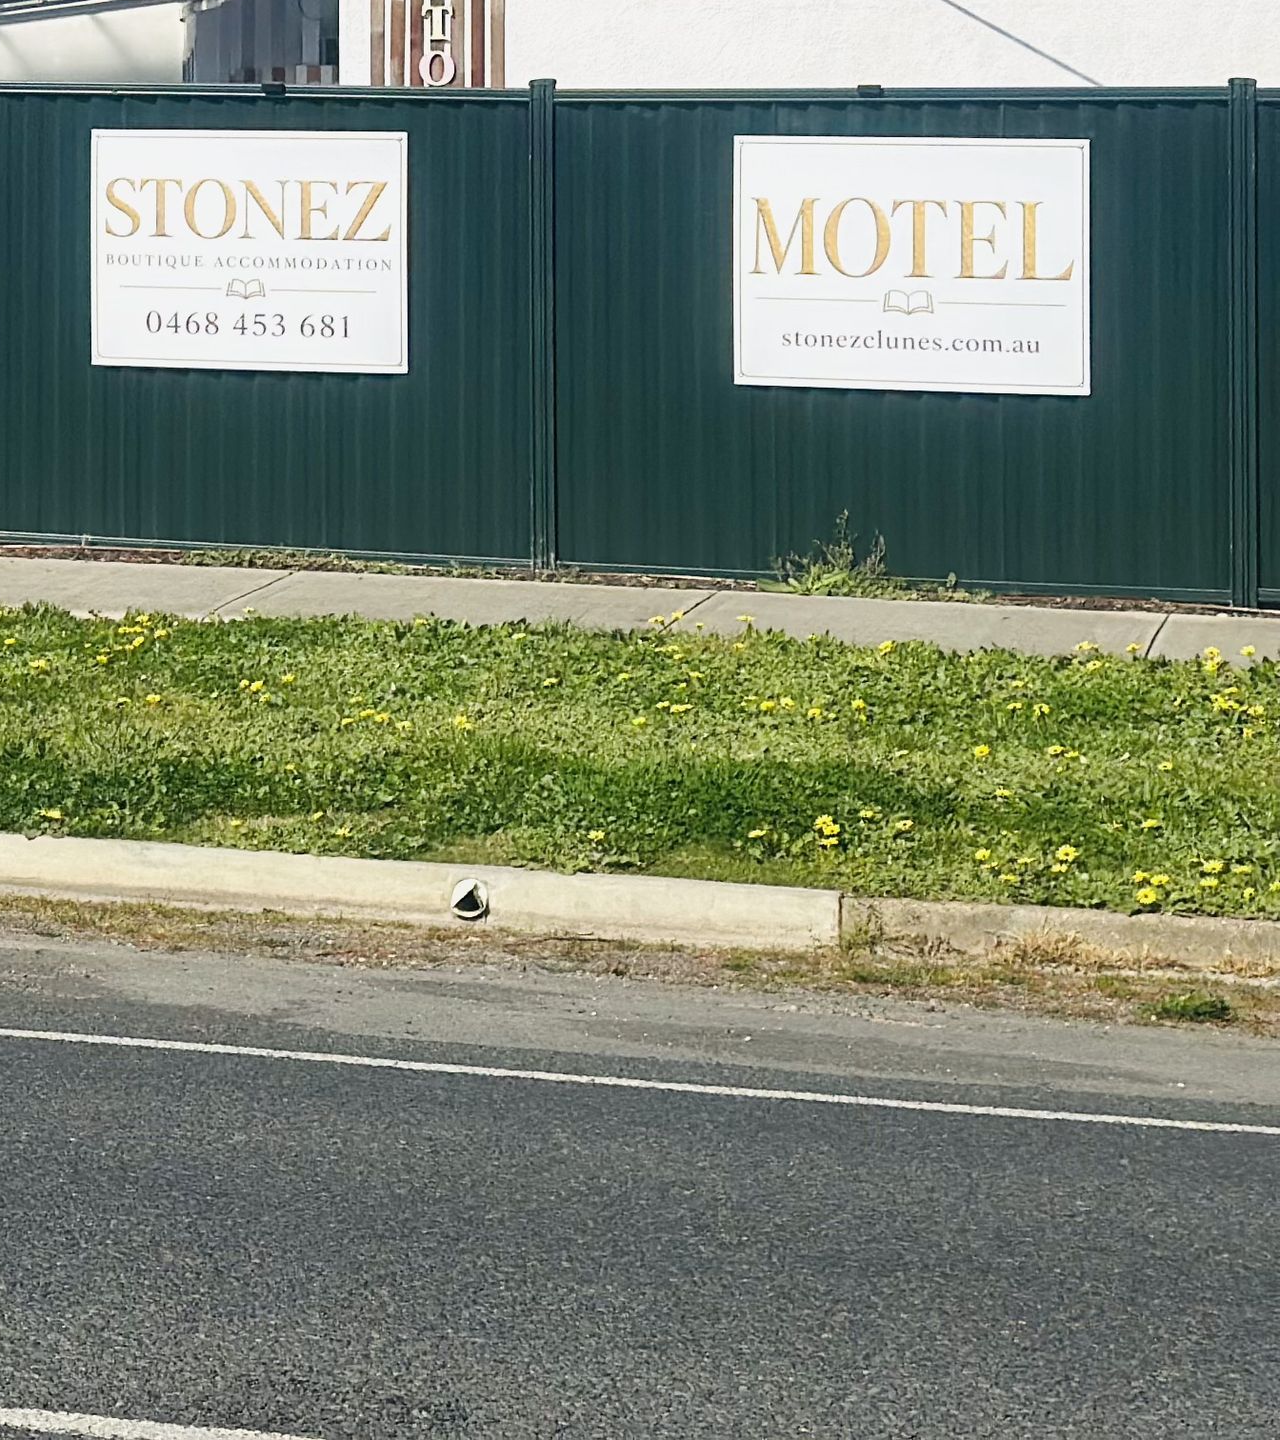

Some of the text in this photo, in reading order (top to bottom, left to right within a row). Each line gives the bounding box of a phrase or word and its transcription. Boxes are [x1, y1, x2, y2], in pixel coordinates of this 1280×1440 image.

[105, 177, 392, 242] STONEZ
[748, 197, 1075, 281] MOTEL
[106, 253, 392, 271] BOUTIQUE ACCOMMODATION
[146, 310, 350, 338] 0468 453 681
[781, 331, 1040, 354] stonezclunes.com.au
